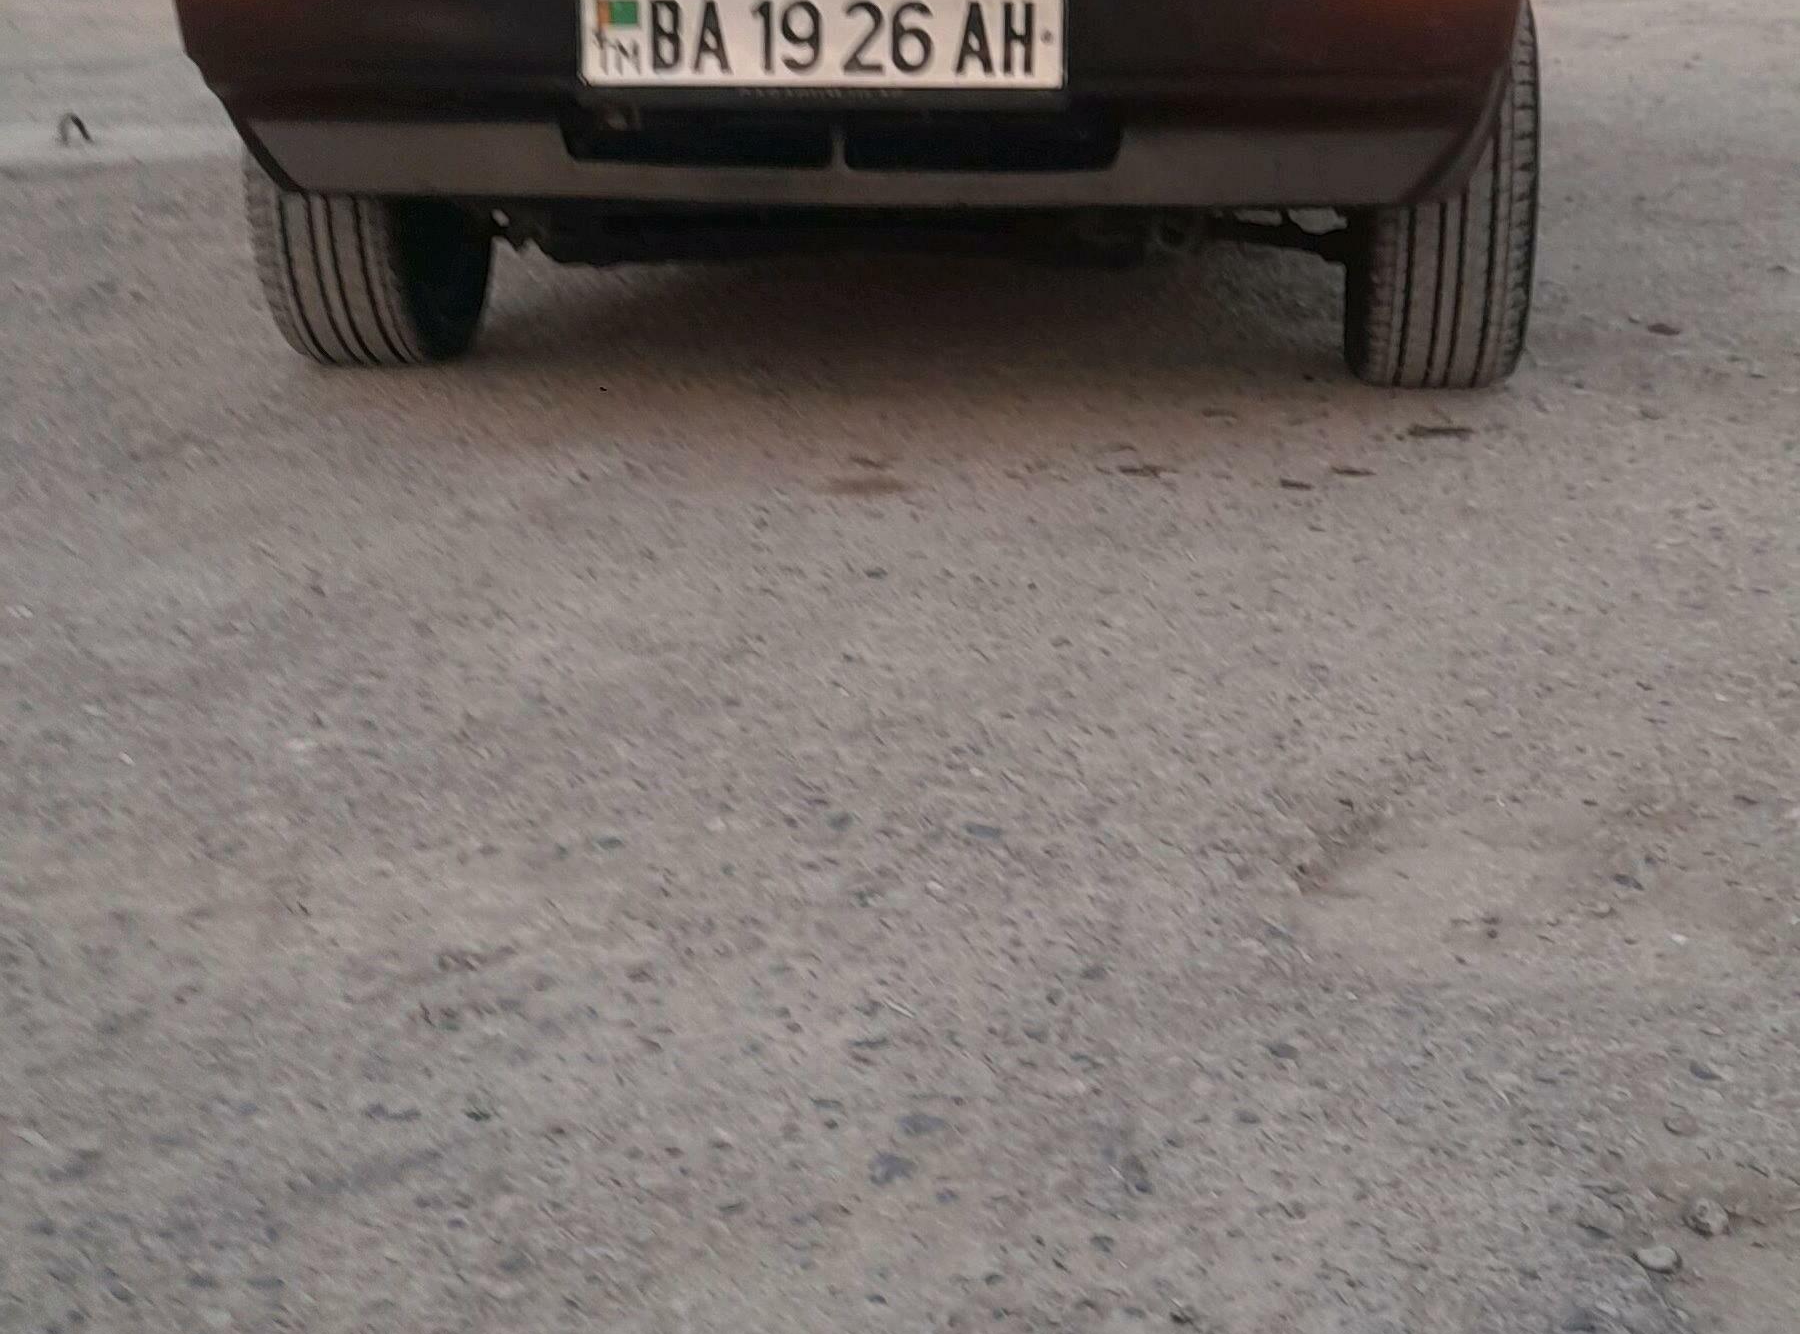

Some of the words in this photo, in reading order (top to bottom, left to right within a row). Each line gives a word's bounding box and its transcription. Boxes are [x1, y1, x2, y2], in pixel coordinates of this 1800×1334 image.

[752, 0, 821, 73] 19
[843, 0, 933, 73] 26
[955, 0, 1034, 75] AH
